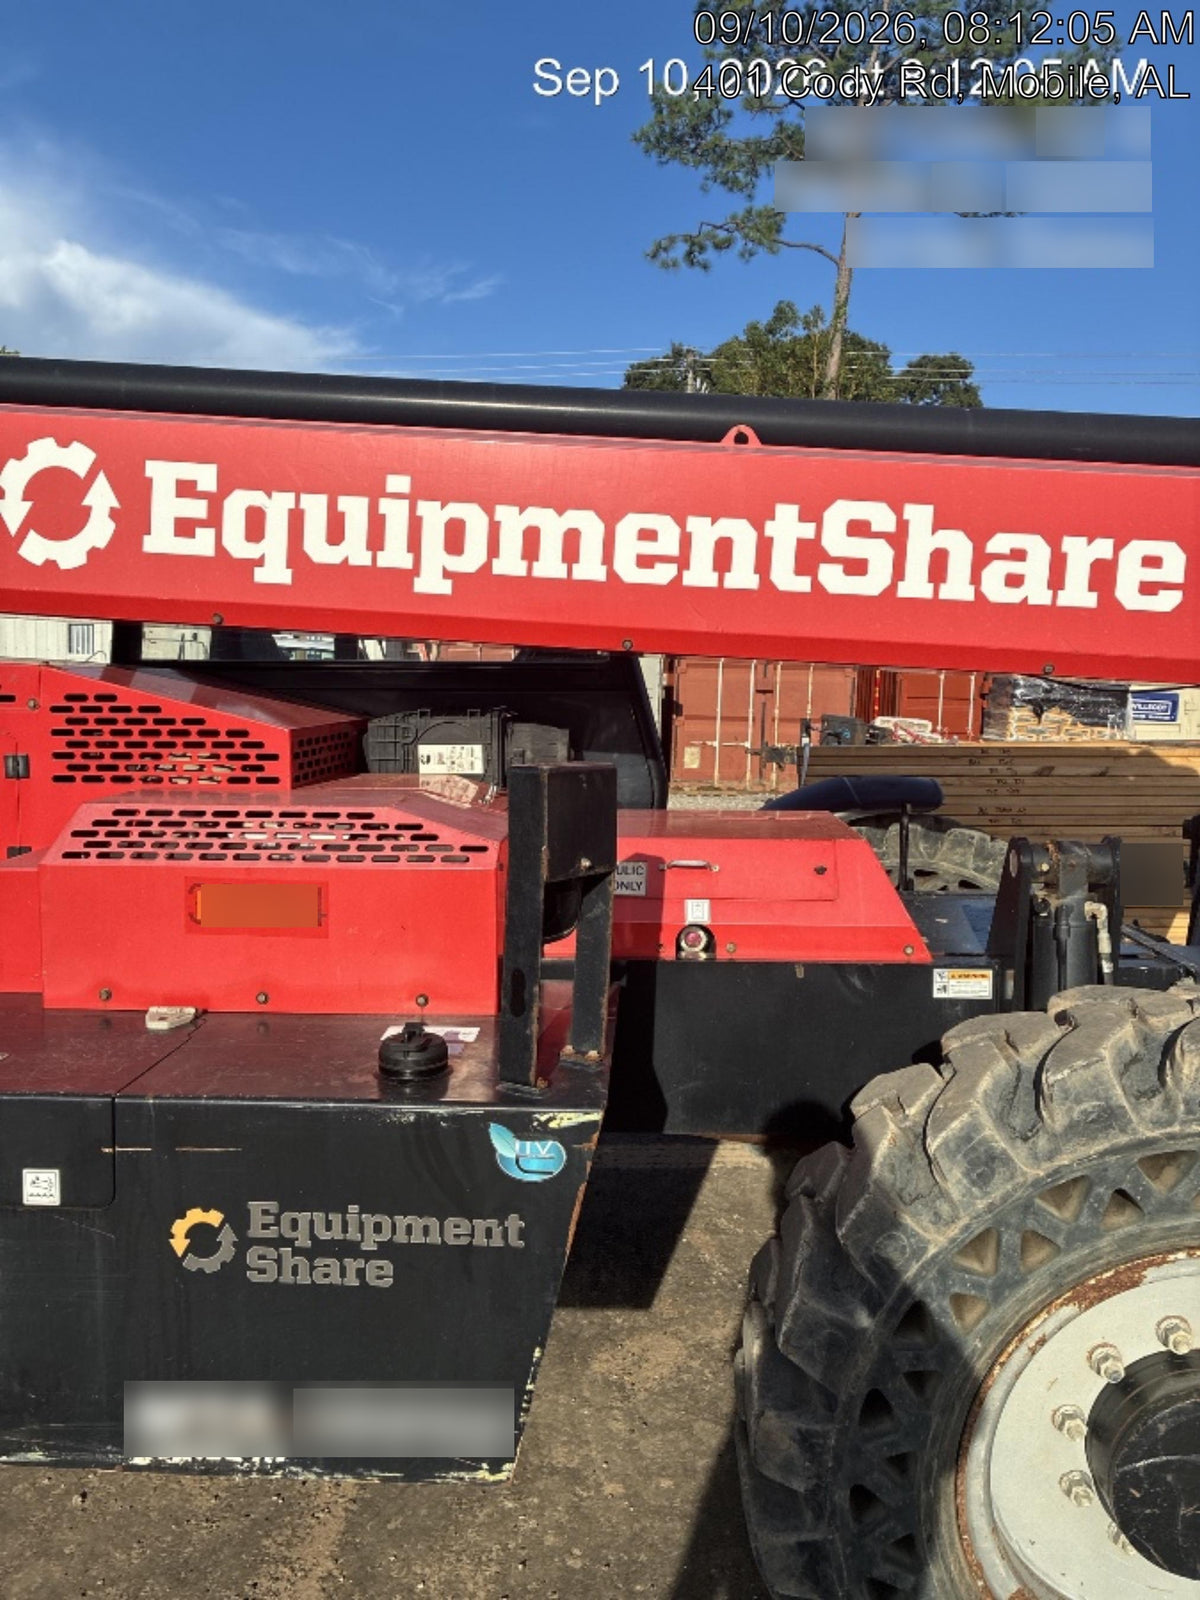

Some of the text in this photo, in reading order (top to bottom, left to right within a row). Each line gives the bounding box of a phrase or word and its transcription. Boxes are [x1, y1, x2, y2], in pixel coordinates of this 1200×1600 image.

[142, 460, 1186, 612] EquipmentShare
[247, 1201, 525, 1250] Equipment
[246, 1246, 394, 1288] Share
